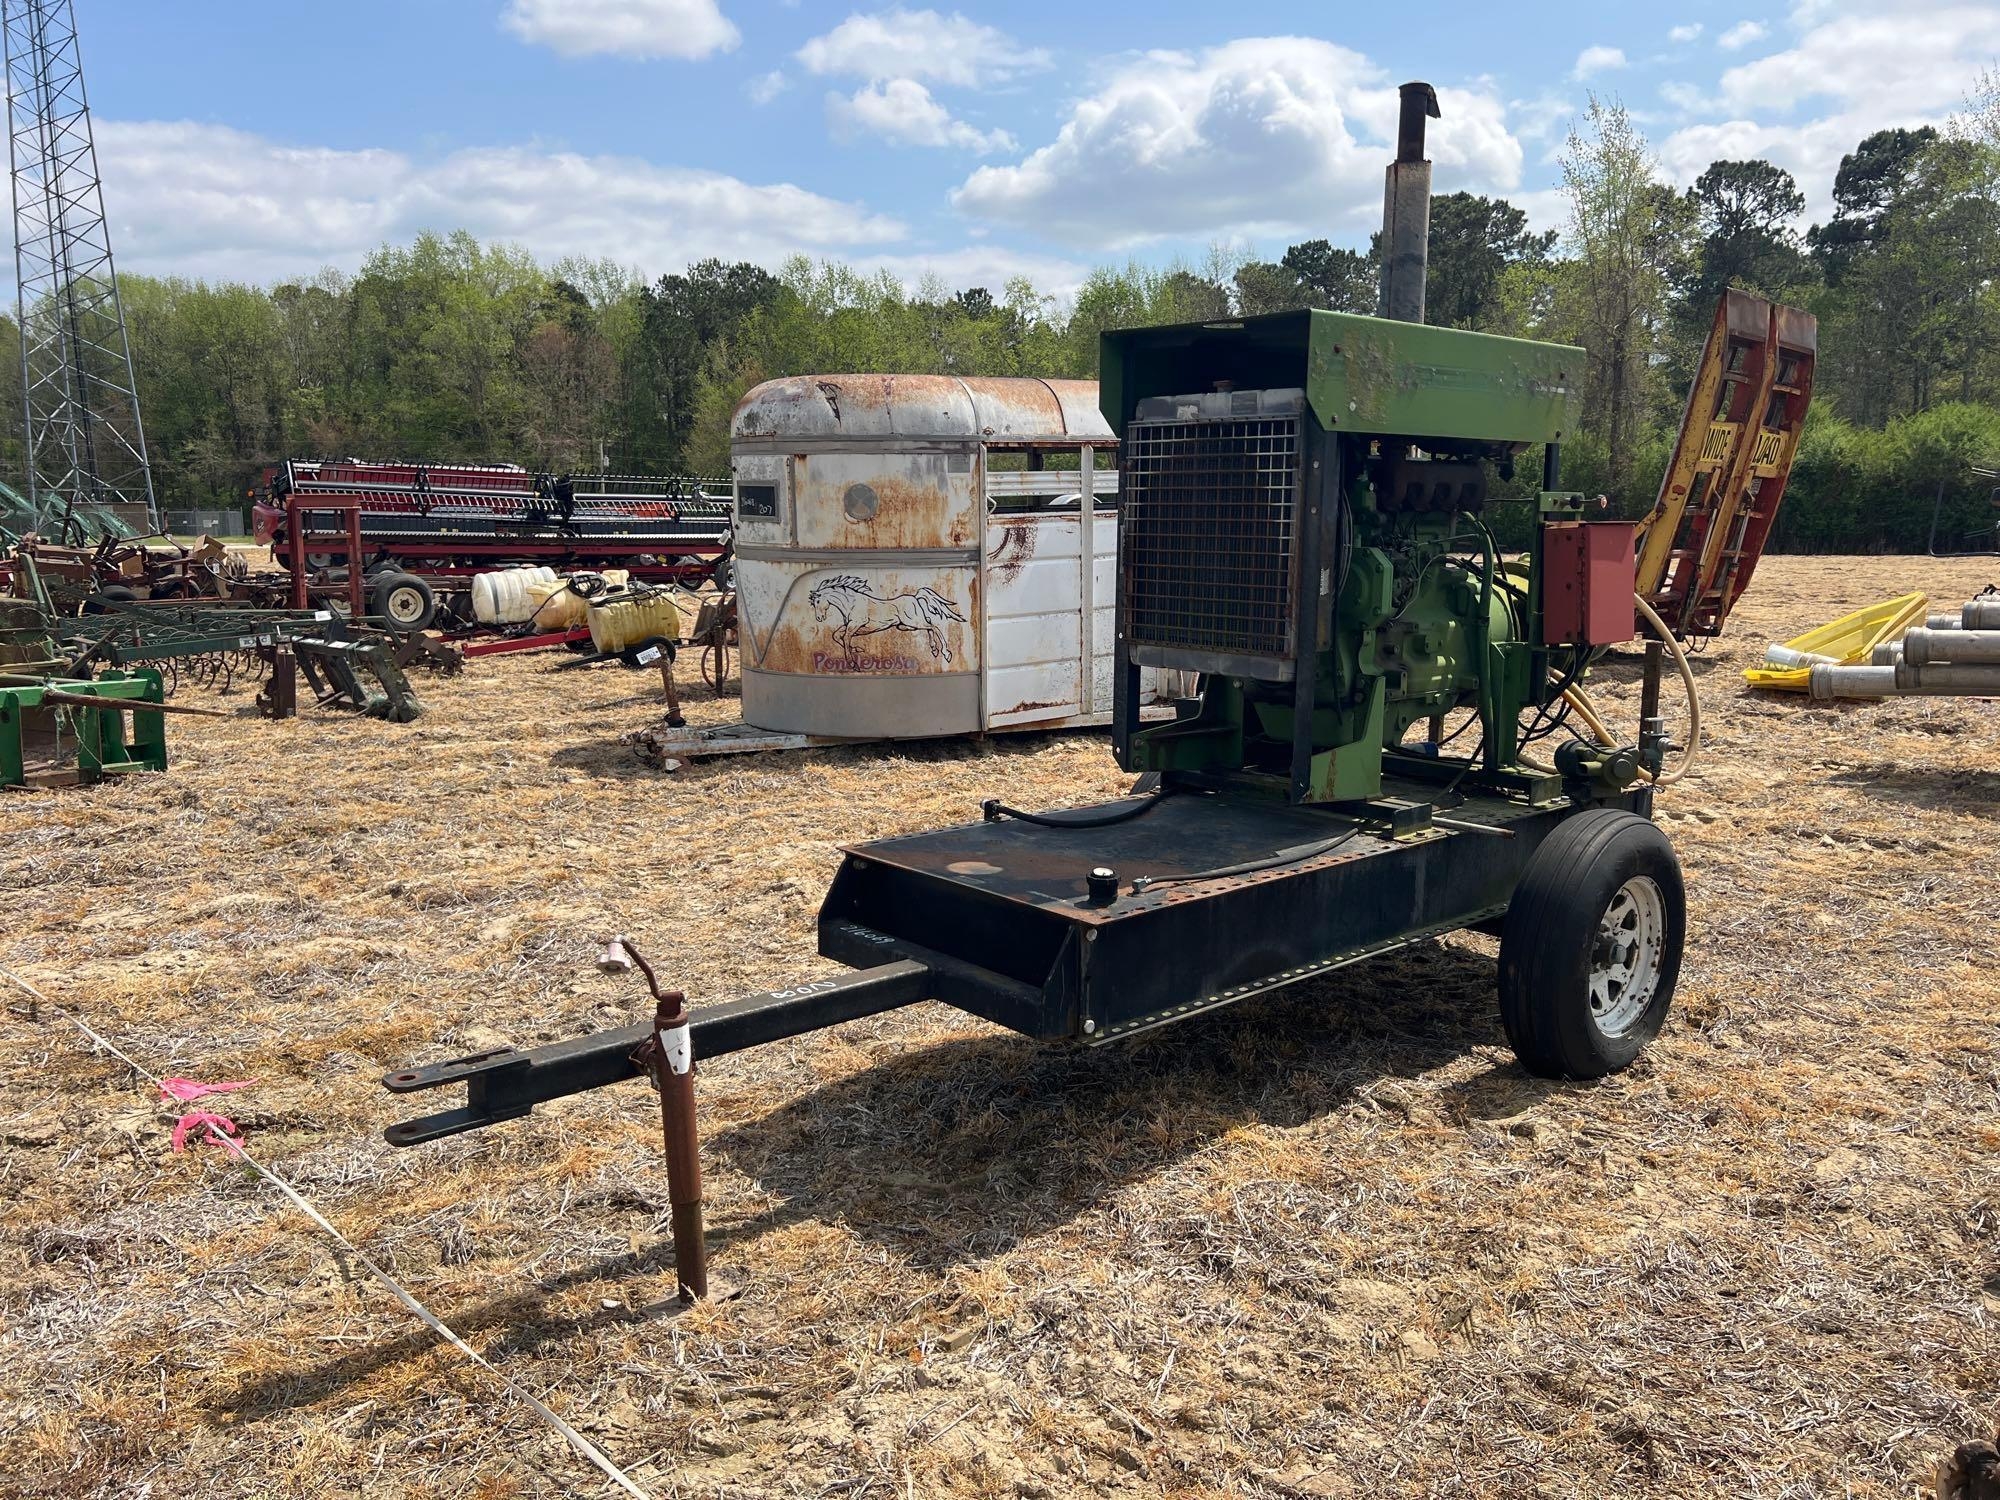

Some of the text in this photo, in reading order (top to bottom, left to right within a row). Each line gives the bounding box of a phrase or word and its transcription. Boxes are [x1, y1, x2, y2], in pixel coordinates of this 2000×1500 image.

[1702, 428, 1781, 465] WIDE LOAD
[759, 504, 772, 515] 207
[813, 652, 918, 671] Ponderosa
